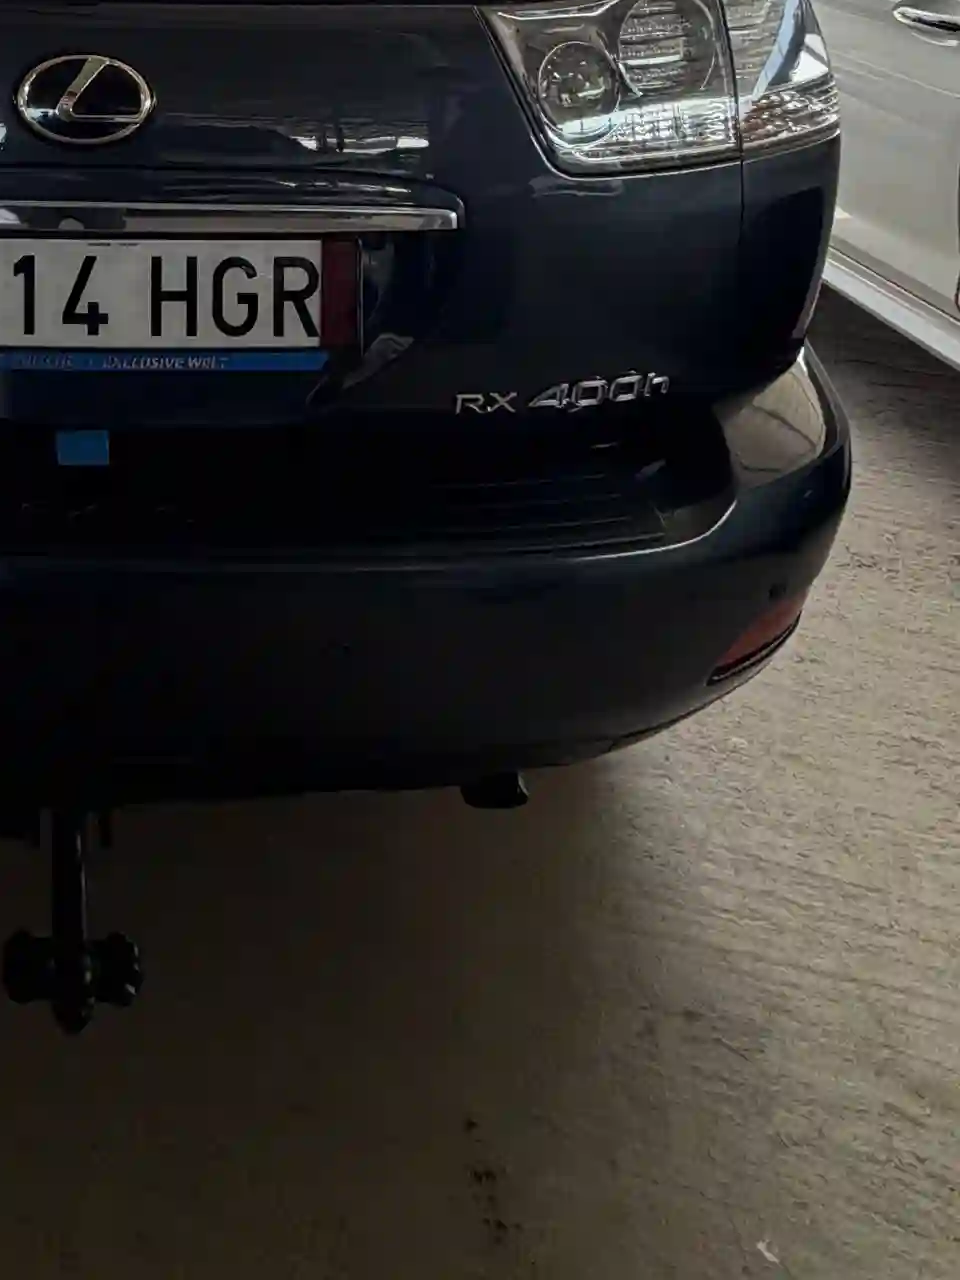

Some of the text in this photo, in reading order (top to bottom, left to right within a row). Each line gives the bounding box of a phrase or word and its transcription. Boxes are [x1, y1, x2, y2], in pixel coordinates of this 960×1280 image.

[150, 255, 320, 338] HGR
[455, 370, 670, 414] RX 400h
